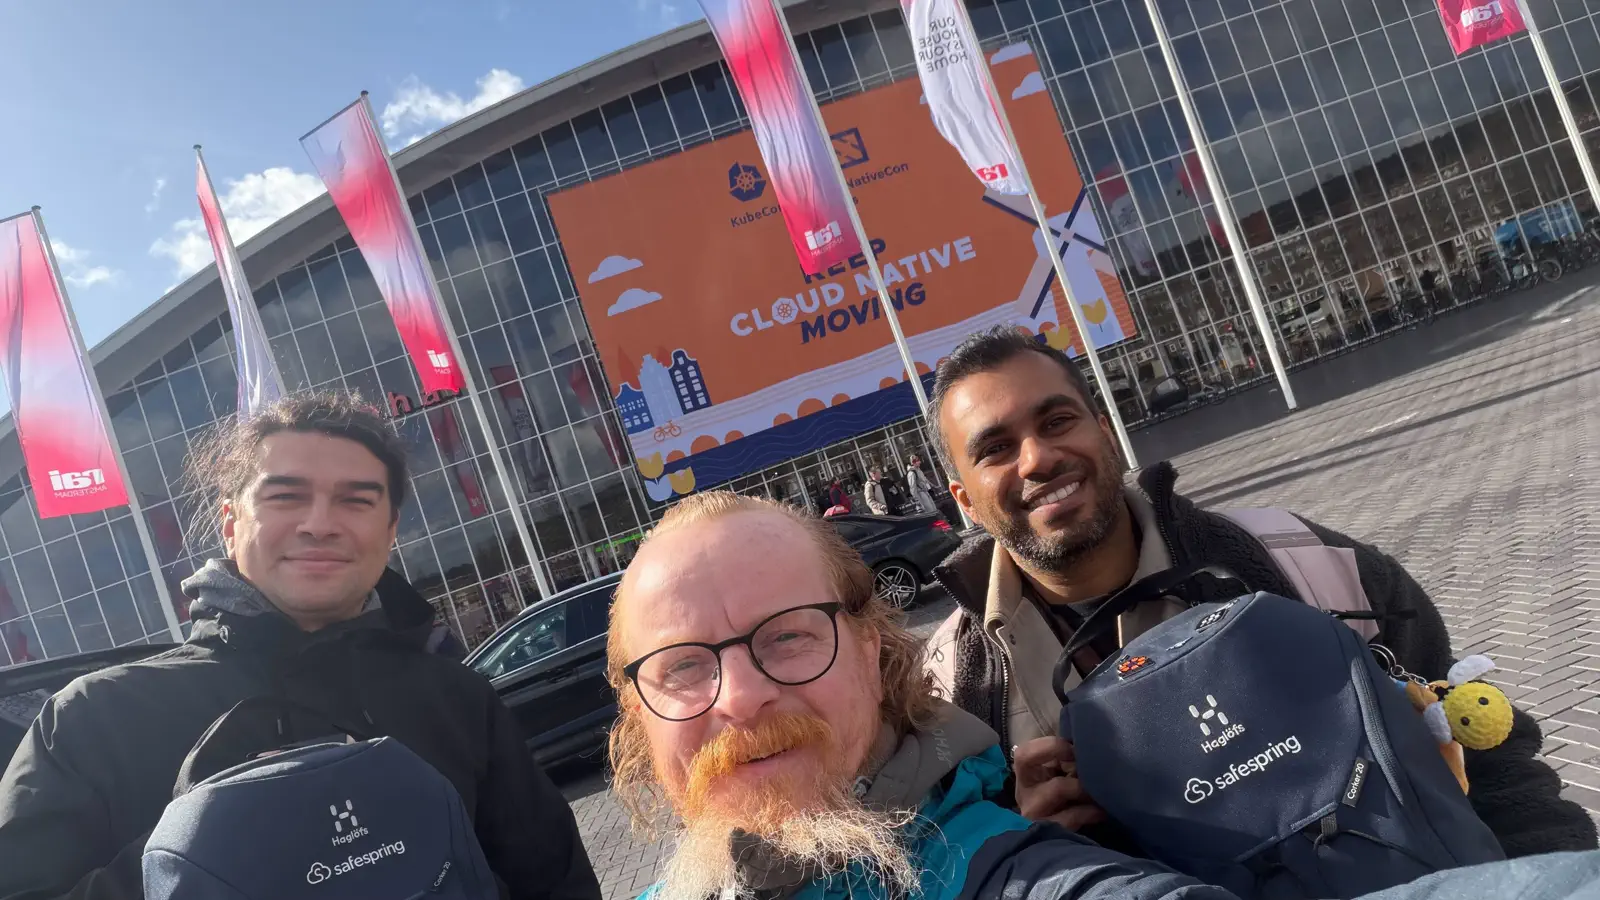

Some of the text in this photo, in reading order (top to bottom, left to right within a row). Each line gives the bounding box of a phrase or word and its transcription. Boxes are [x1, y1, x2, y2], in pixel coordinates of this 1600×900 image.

[847, 162, 908, 188] NativeCon
[730, 236, 976, 336] CLOUD NATIVE
[1201, 724, 1246, 753] Haglöfs
[1215, 734, 1302, 790] safespring
[1347, 764, 1364, 799] Corker 20
[332, 826, 369, 846] Haglöfs
[334, 840, 405, 875] safespring
